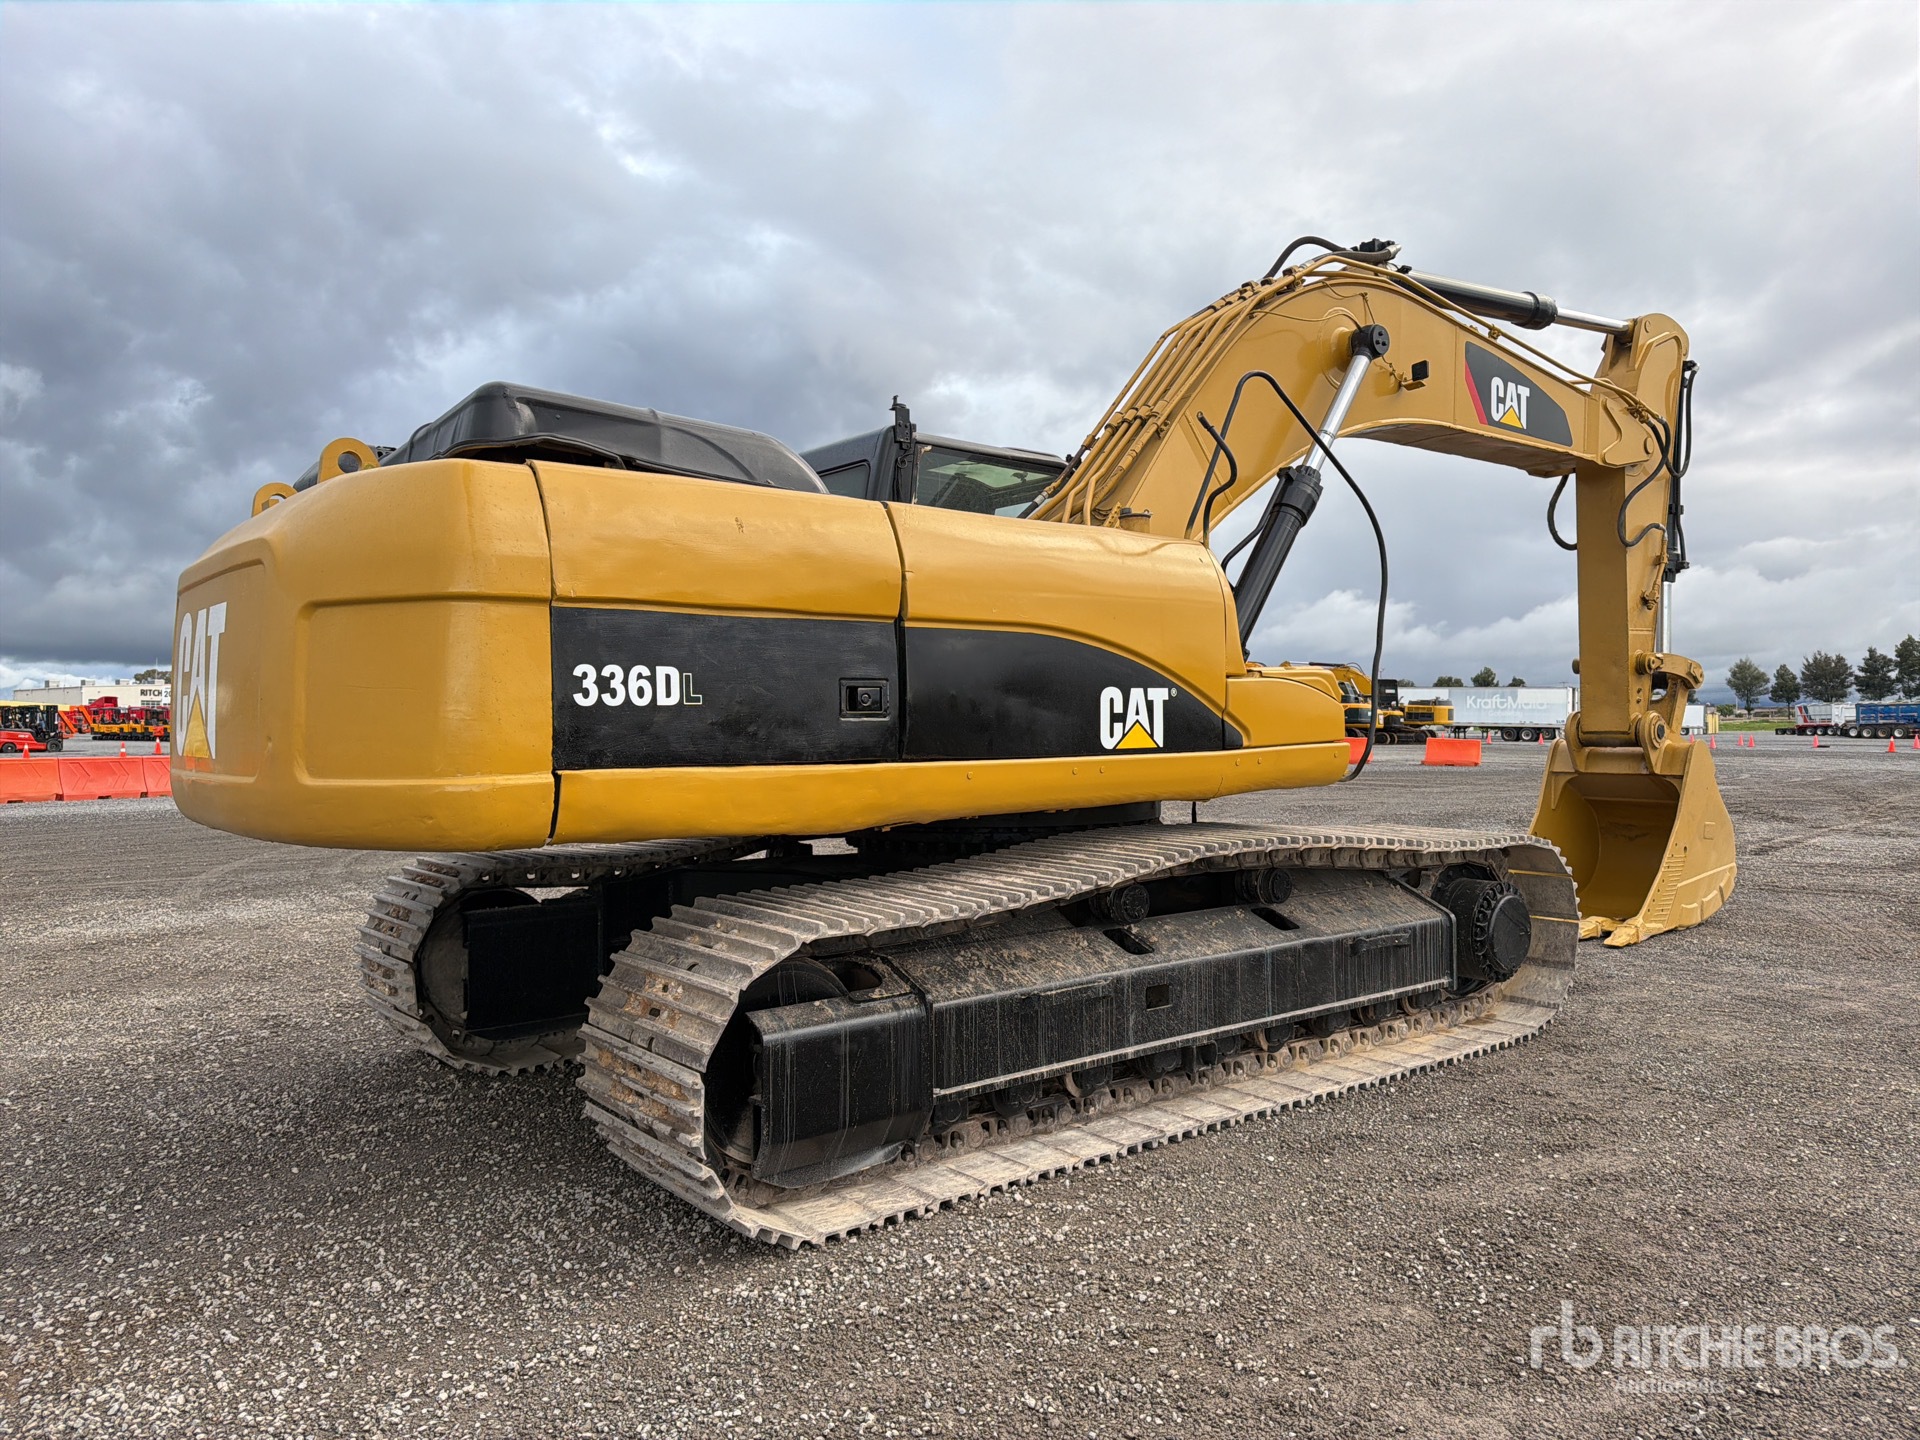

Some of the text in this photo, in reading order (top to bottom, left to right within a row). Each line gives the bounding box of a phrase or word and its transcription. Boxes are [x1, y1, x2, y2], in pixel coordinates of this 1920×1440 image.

[1490, 376, 1530, 430] CAT
[176, 601, 228, 760] CAT
[1100, 686, 1170, 750] CAT
